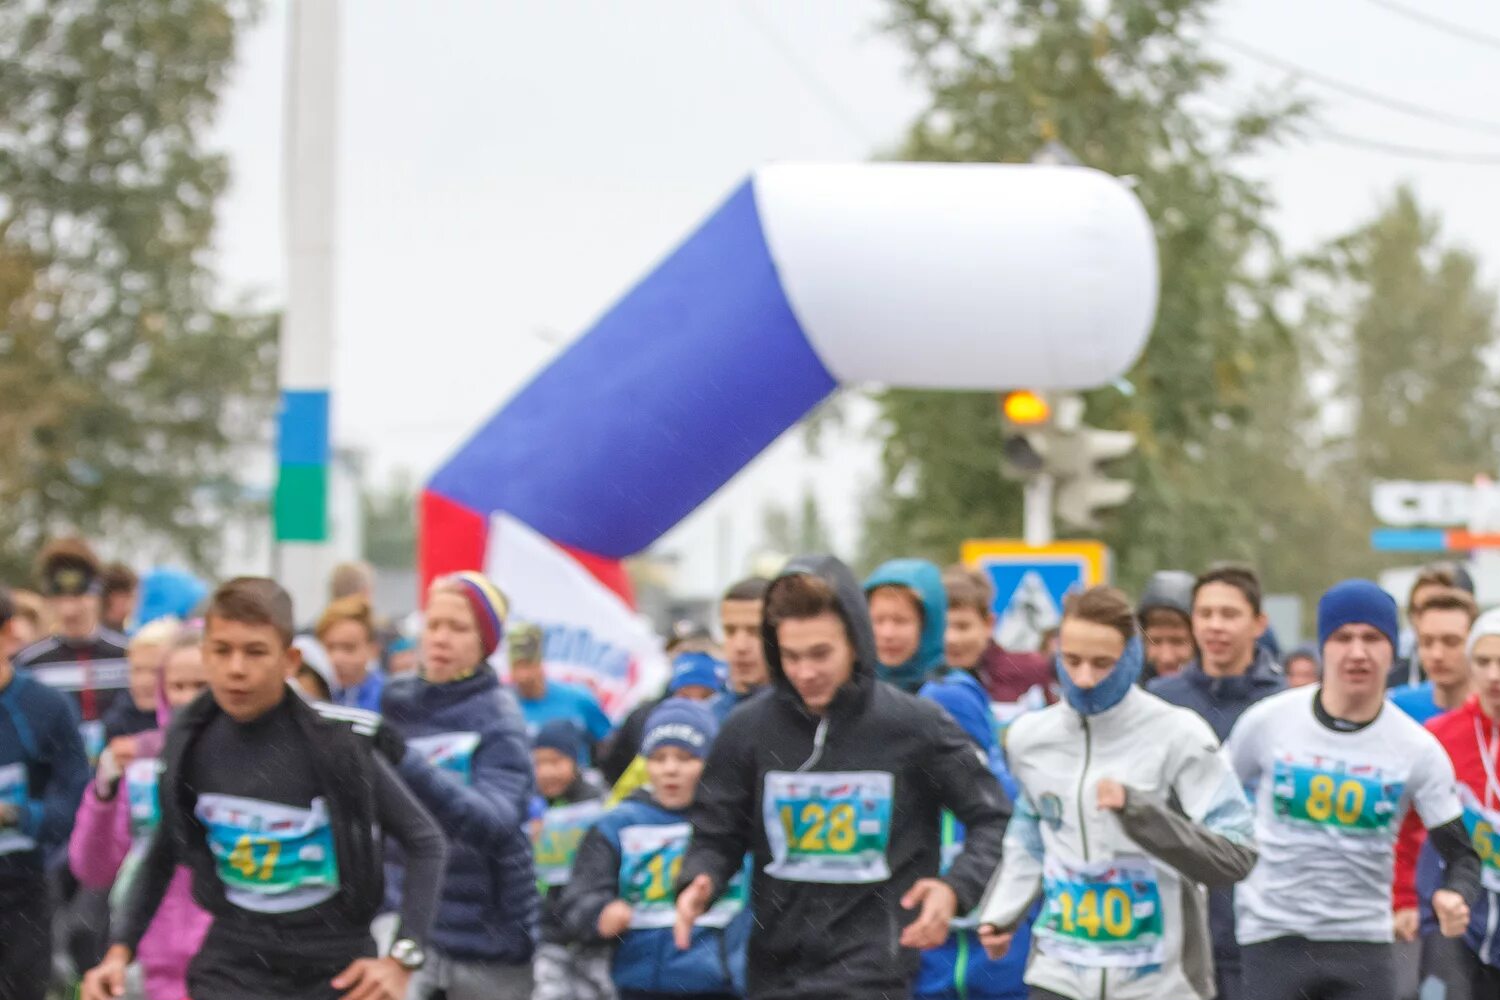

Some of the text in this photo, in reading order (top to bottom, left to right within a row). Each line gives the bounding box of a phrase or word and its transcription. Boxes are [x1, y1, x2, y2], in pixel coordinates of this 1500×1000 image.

[1306, 775, 1364, 823] 80
[780, 804, 856, 851] 128
[229, 837, 280, 879] 47
[645, 856, 683, 899] 1
[1059, 888, 1132, 937] 140
